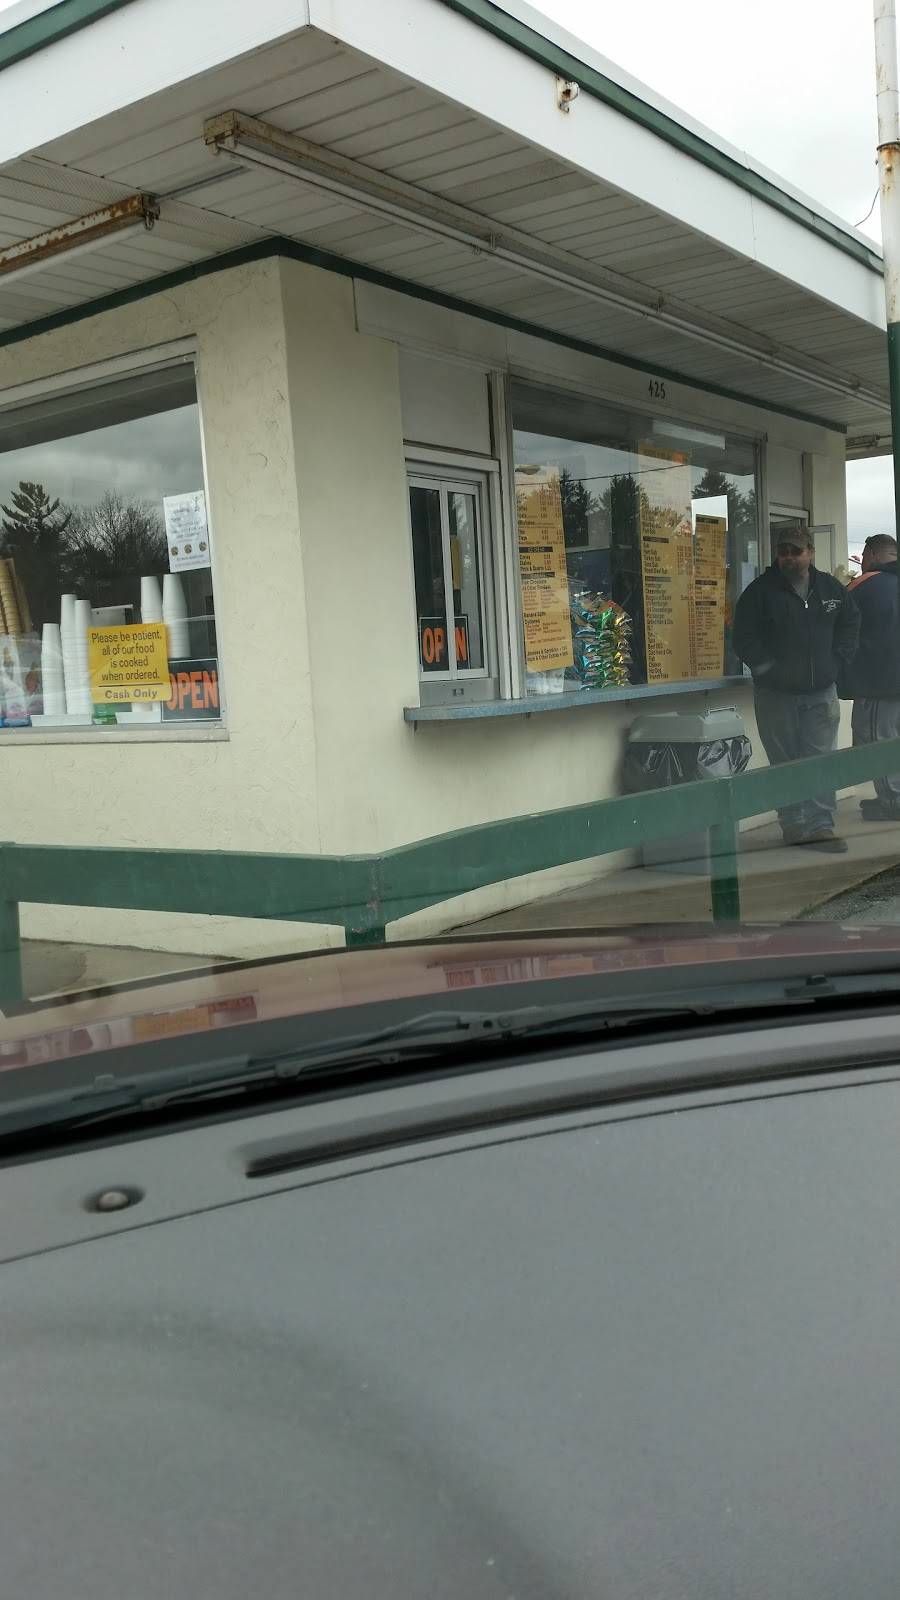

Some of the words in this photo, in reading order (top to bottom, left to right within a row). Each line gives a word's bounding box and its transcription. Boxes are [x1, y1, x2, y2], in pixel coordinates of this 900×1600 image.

[648, 379, 666, 400] 425
[91, 632, 119, 643] Please
[119, 631, 131, 641] be
[102, 644, 111, 655] all
[112, 644, 121, 655] of
[121, 646, 135, 655] our
[135, 642, 155, 654] food
[422, 627, 467, 664] OPN
[110, 657, 119, 668] is
[119, 656, 148, 667] cooked
[102, 669, 124, 681] when
[125, 667, 160, 680] ordered.
[105, 689, 130, 699] Cash
[133, 688, 158, 699] Only
[166, 670, 218, 711] OPEN
